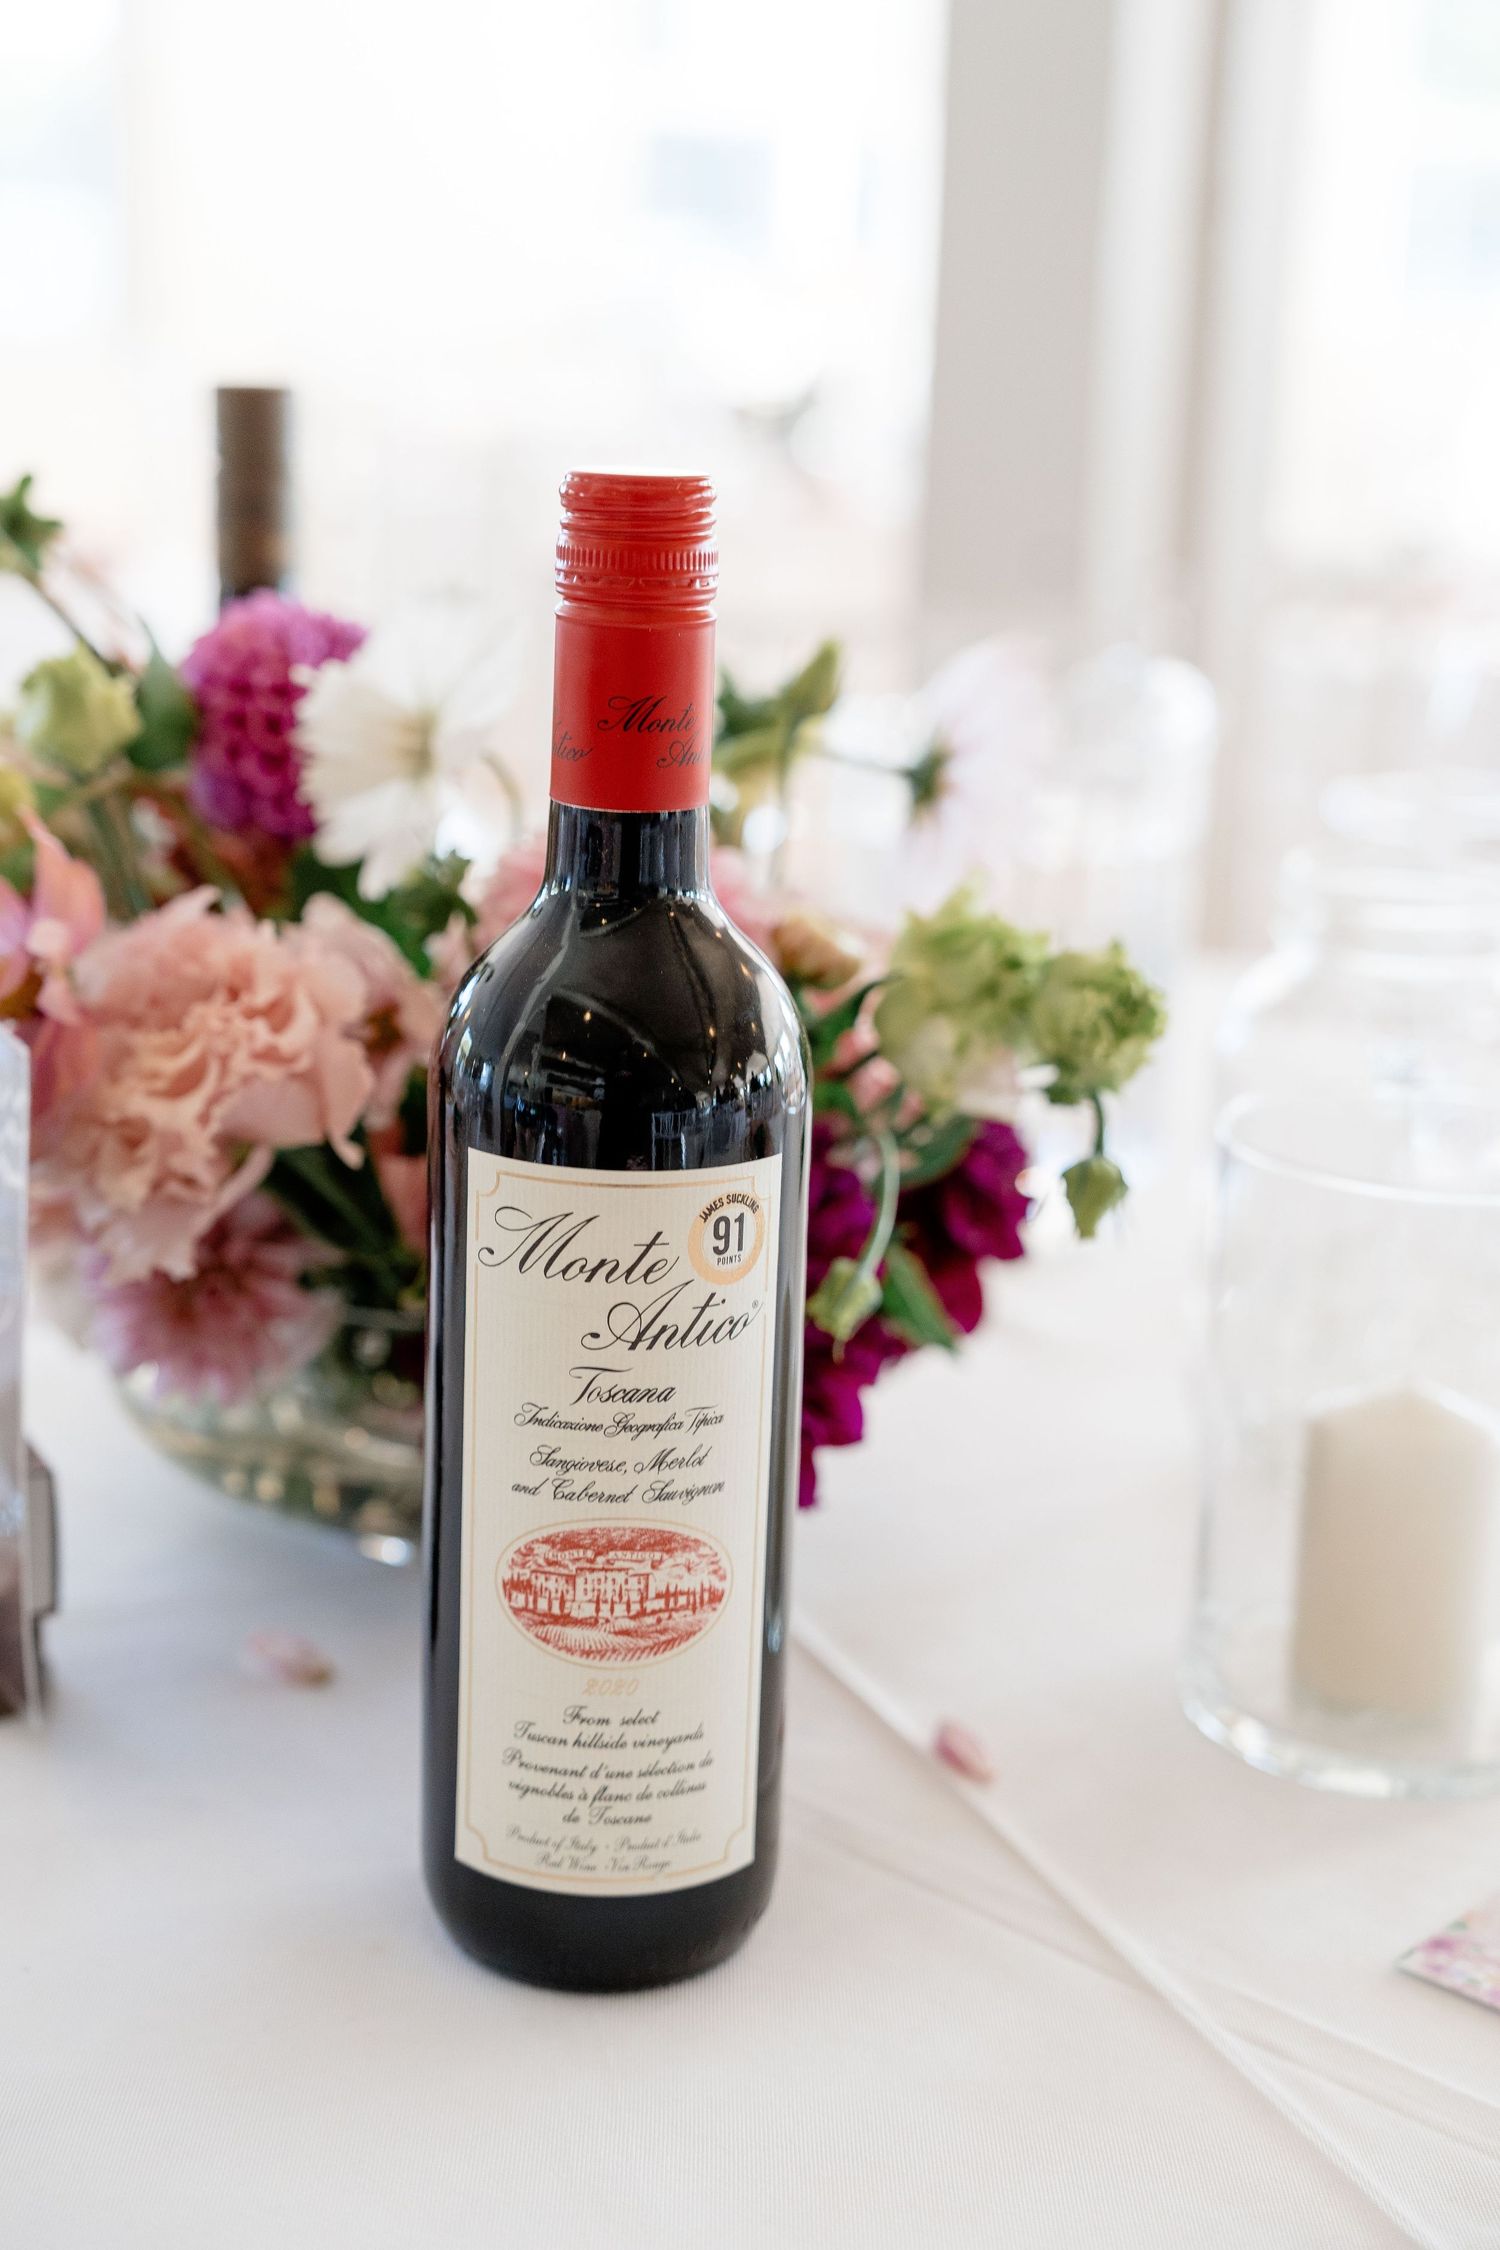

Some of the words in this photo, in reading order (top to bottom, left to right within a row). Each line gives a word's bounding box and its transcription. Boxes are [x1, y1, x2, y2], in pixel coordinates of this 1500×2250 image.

[597, 694, 698, 734] Monte
[699, 1197, 724, 1223] JAMES
[726, 1193, 760, 1214] SUCKLING
[478, 1206, 680, 1284] Monte
[712, 1212, 745, 1256] 91
[716, 1254, 742, 1266] POINTS
[568, 1366, 677, 1406] Toscana
[513, 1402, 603, 1433] Indicazione
[603, 1411, 684, 1441] Geografica
[684, 1404, 726, 1440] Tipica
[529, 1444, 628, 1476] Sangiovese,
[633, 1443, 713, 1476] Merlot
[511, 1477, 550, 1497] and
[551, 1477, 639, 1504] Cabernet
[641, 1478, 726, 1506] Sauvignon
[581, 1677, 639, 1697] 2020
[562, 1704, 611, 1727] From
[619, 1707, 661, 1727] select
[513, 1720, 569, 1747] Tuscan
[571, 1731, 628, 1750] hillside
[632, 1720, 705, 1755] vineyards
[501, 1746, 589, 1779] Provenant
[589, 1761, 633, 1780] d'une
[508, 1781, 574, 1800] vignobles
[577, 1787, 589, 1801] à
[588, 1783, 632, 1809] flanc
[635, 1783, 654, 1802] de
[656, 1778, 707, 1801] collines
[561, 1806, 580, 1823] de
[587, 1805, 653, 1827] Toscane
